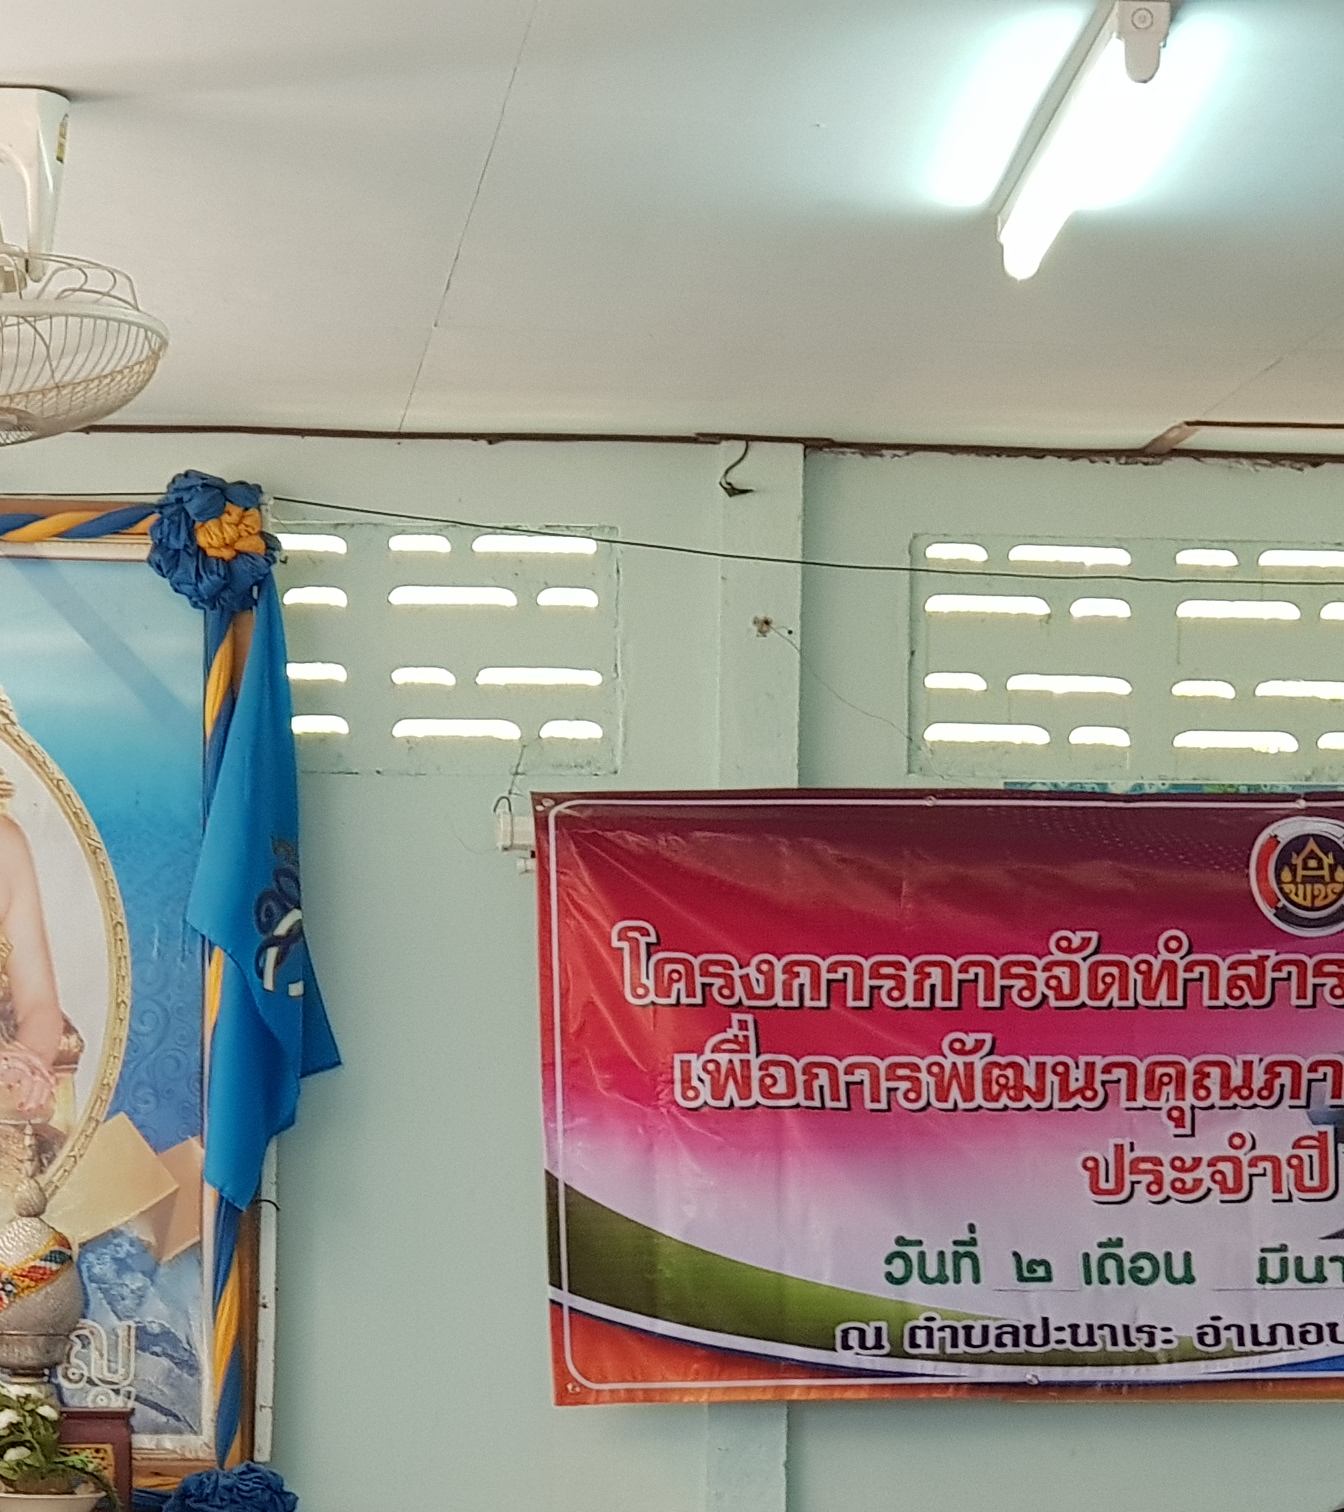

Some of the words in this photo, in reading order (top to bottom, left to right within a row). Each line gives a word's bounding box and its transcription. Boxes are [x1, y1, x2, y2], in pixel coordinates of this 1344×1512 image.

[1081, 1128, 1332, 1199] ประจำปี
[883, 1222, 983, 1286] วันที่
[1010, 1249, 1054, 1284] ๒
[1081, 1236, 1197, 1287] เดือน
[839, 1322, 887, 1353] ณ
[906, 1314, 1175, 1351] ตำบลปะนาเระ
